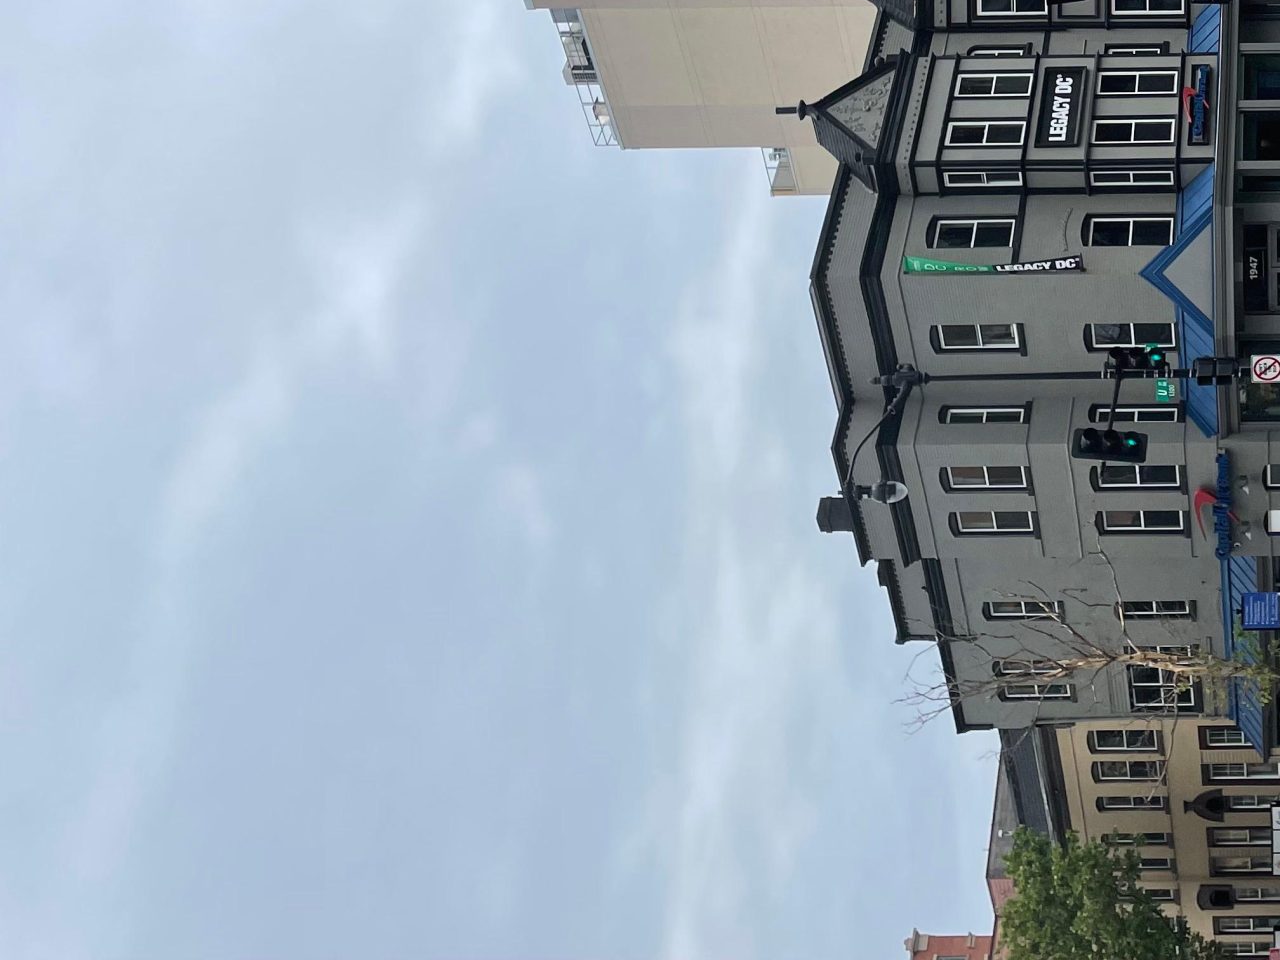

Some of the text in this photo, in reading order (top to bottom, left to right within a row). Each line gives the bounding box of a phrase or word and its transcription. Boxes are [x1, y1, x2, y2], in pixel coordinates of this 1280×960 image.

[1048, 95, 1071, 142] LEGACY
[995, 261, 1052, 272] LEGACY
[1249, 256, 1258, 280] 1947
